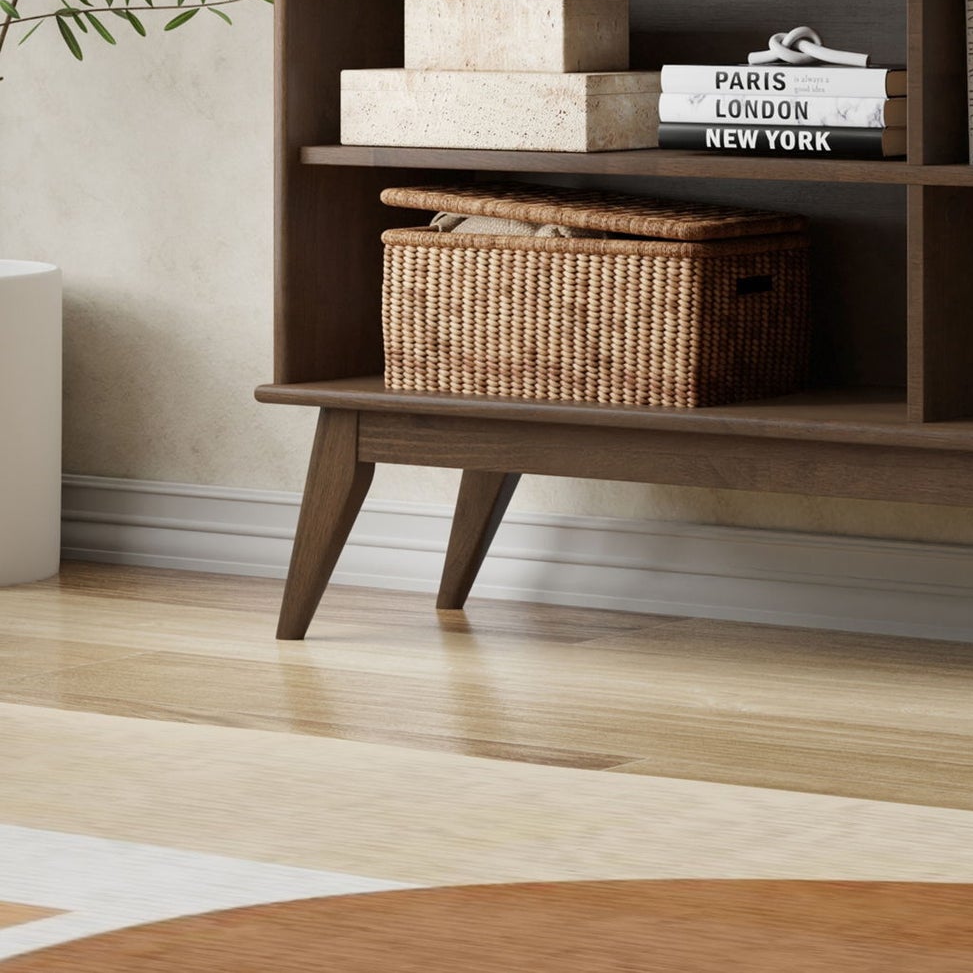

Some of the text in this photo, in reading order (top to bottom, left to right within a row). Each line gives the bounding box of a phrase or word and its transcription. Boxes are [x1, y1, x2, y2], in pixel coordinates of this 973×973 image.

[715, 71, 786, 91] PARIS
[715, 99, 808, 120] LONDON
[705, 128, 831, 151] NEW YORK
